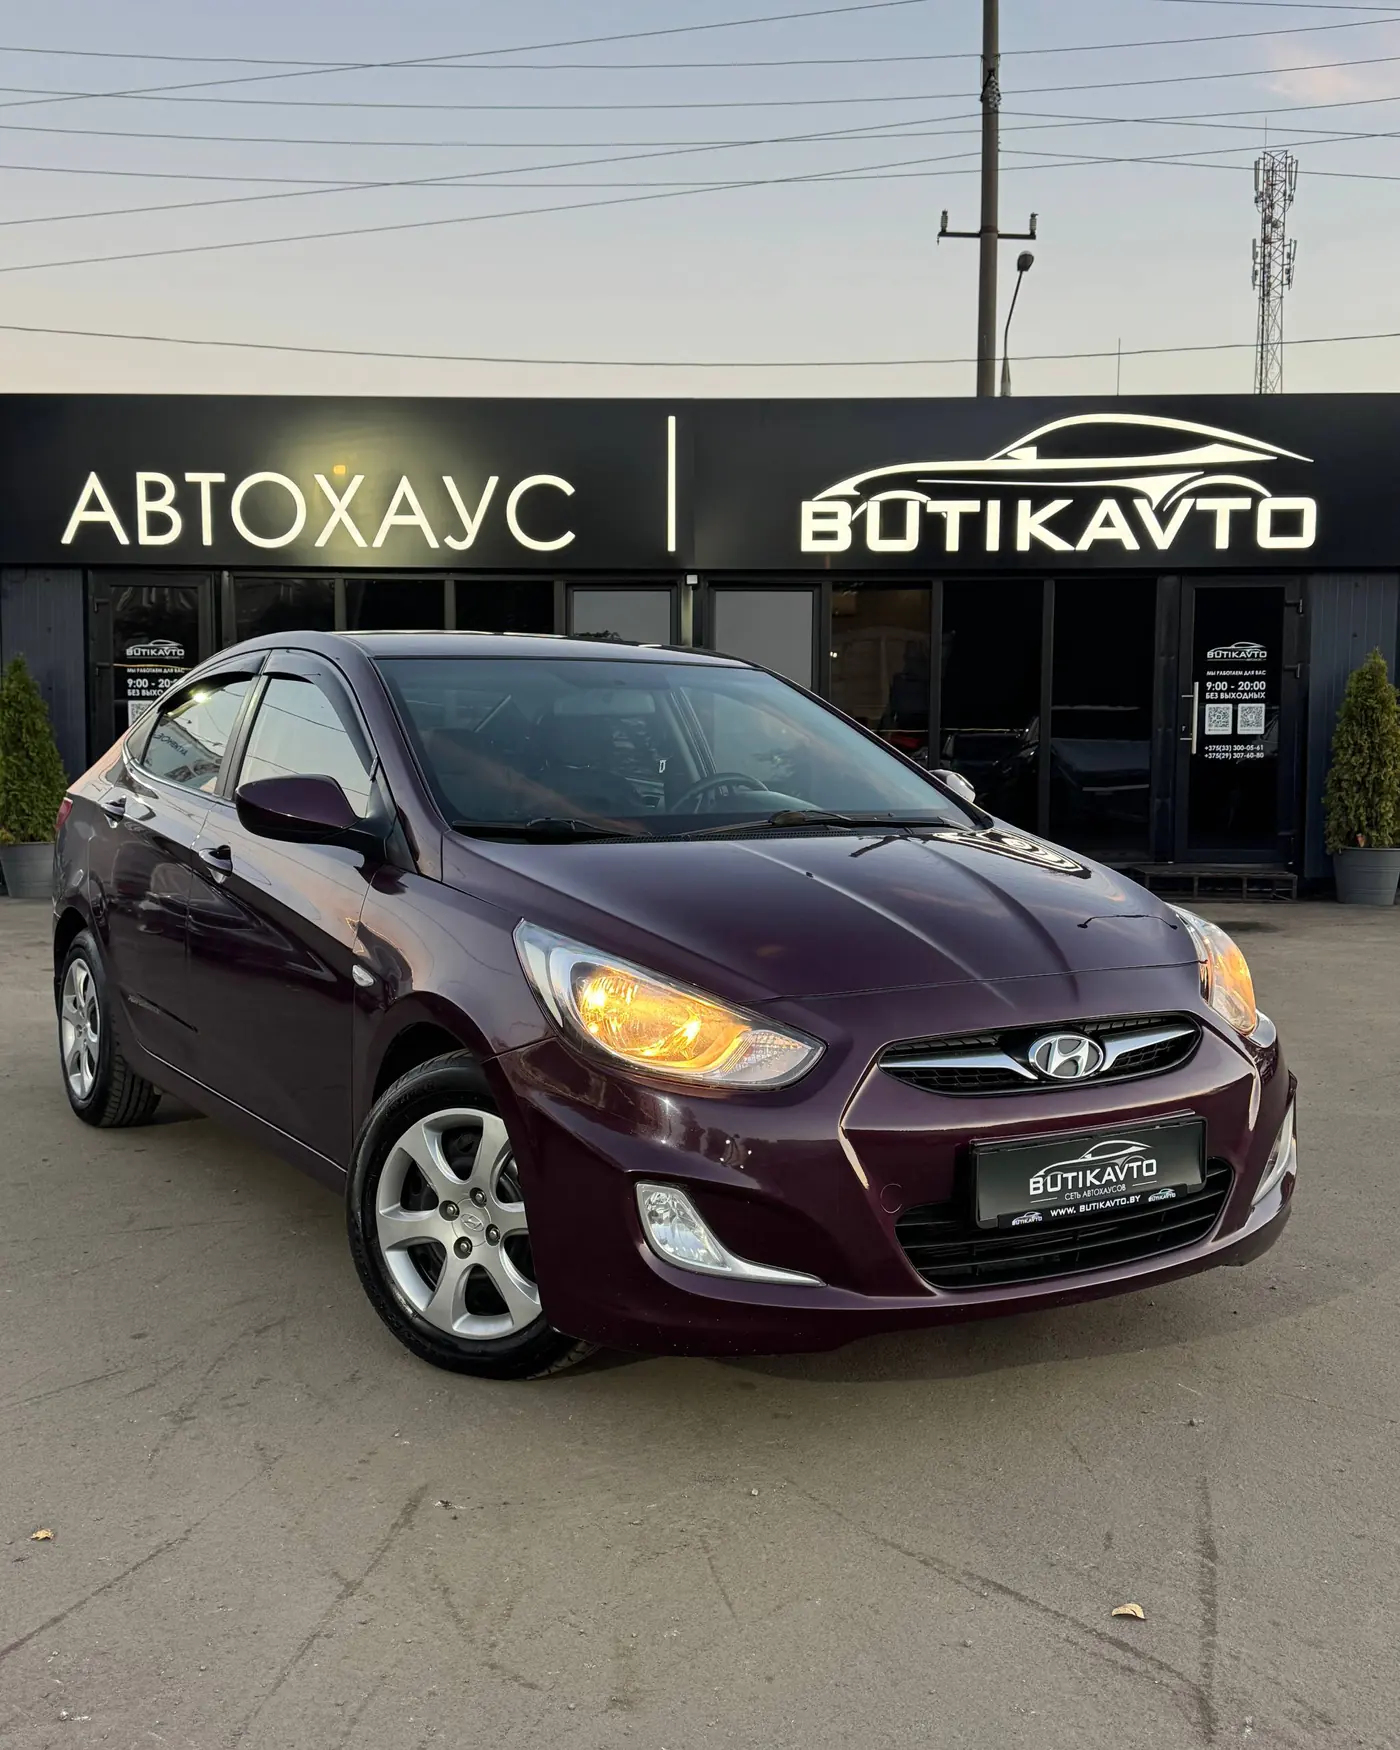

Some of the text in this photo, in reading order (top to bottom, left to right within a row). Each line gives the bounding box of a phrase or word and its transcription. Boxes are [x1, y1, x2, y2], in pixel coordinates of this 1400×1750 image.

[61, 471, 576, 552] АВТОХАУС
[800, 497, 1317, 552] BUTIKAVTO
[126, 648, 185, 656] BUTIKAVTO
[1207, 650, 1268, 659] BUTIKAVTO
[127, 678, 149, 688] 9:00
[1206, 681, 1228, 691] 9:00
[1238, 681, 1266, 691] 20:00
[127, 689, 140, 697] БЕЗ
[1220, 691, 1266, 699] ВЫХОДНЫХ
[1204, 744, 1232, 752] +375(33)
[1029, 1159, 1157, 1196] BUTIKAVTO
[1064, 1184, 1127, 1201] СЕТЬ АВТОХАУСОВ
[1050, 1195, 1142, 1217] WWW. BUTIKAVTO.BY
